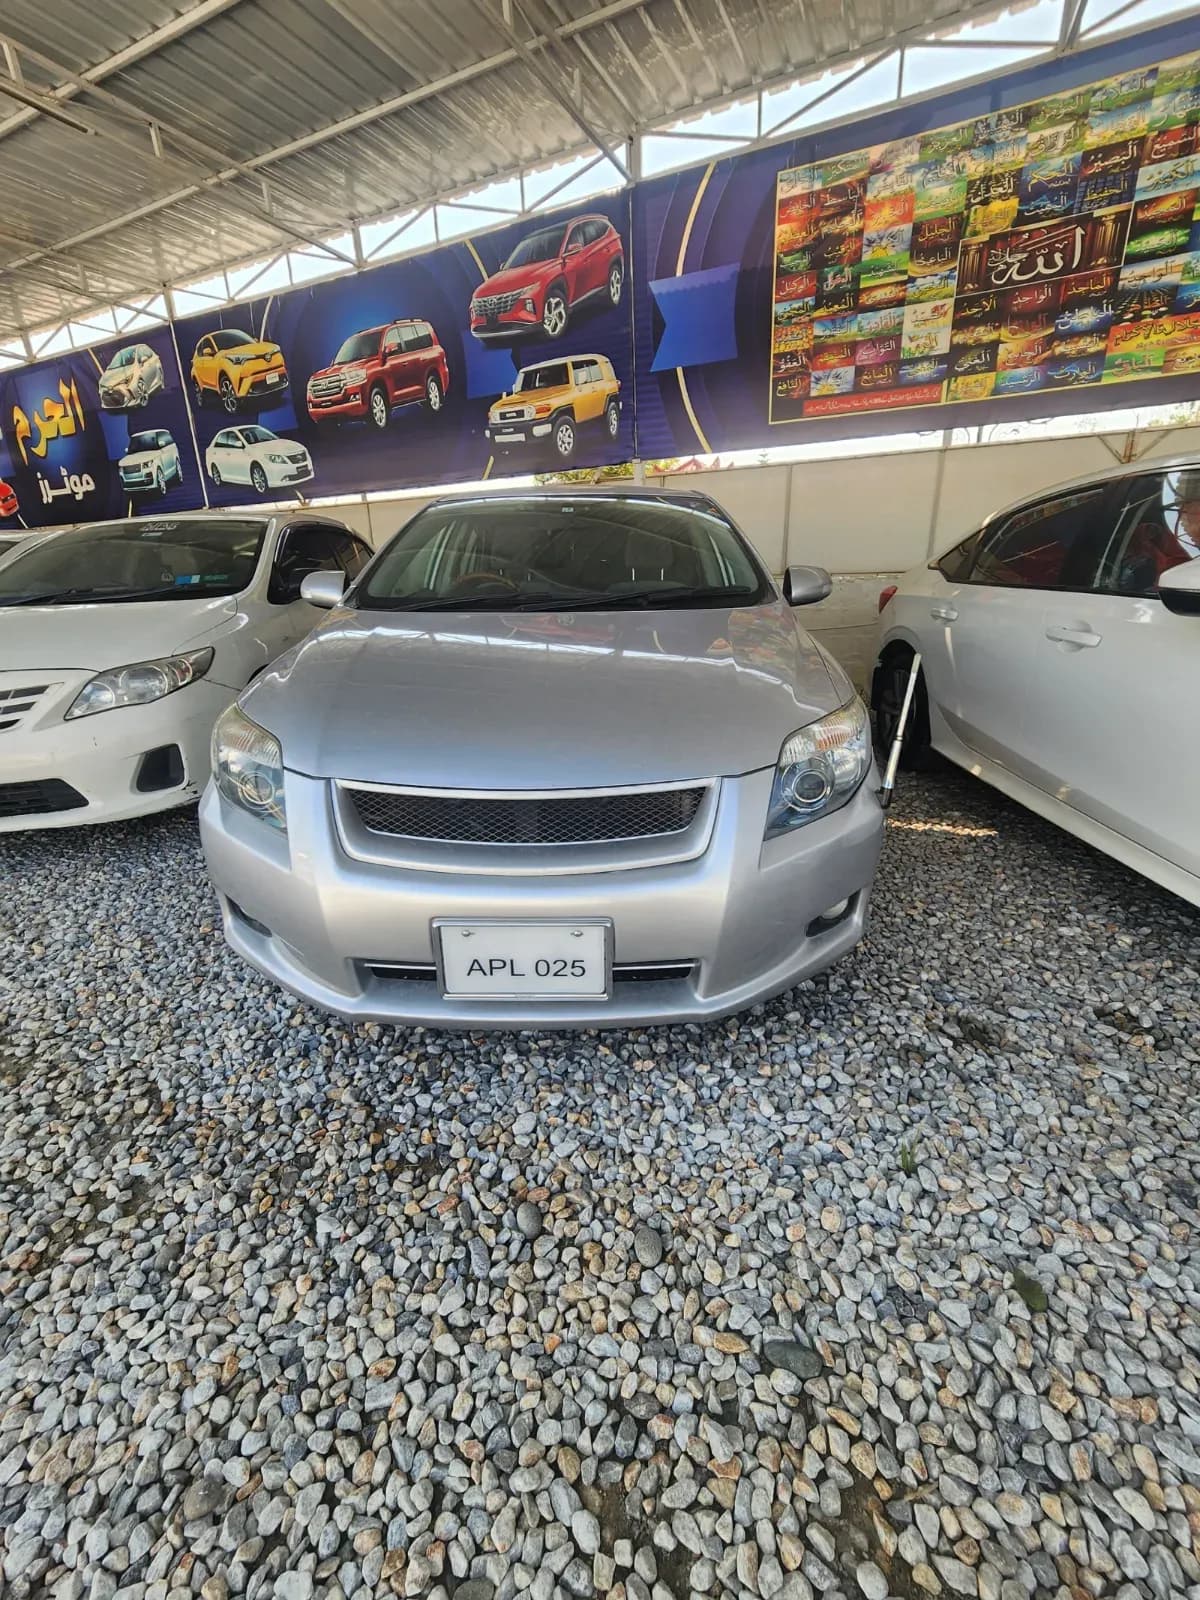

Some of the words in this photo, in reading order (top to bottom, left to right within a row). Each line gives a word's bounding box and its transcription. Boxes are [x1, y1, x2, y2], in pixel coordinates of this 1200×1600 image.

[1087, 140, 1137, 174] البصير
[919, 216, 956, 242] الجليل
[466, 958, 526, 977] APL
[534, 958, 587, 978] 025
